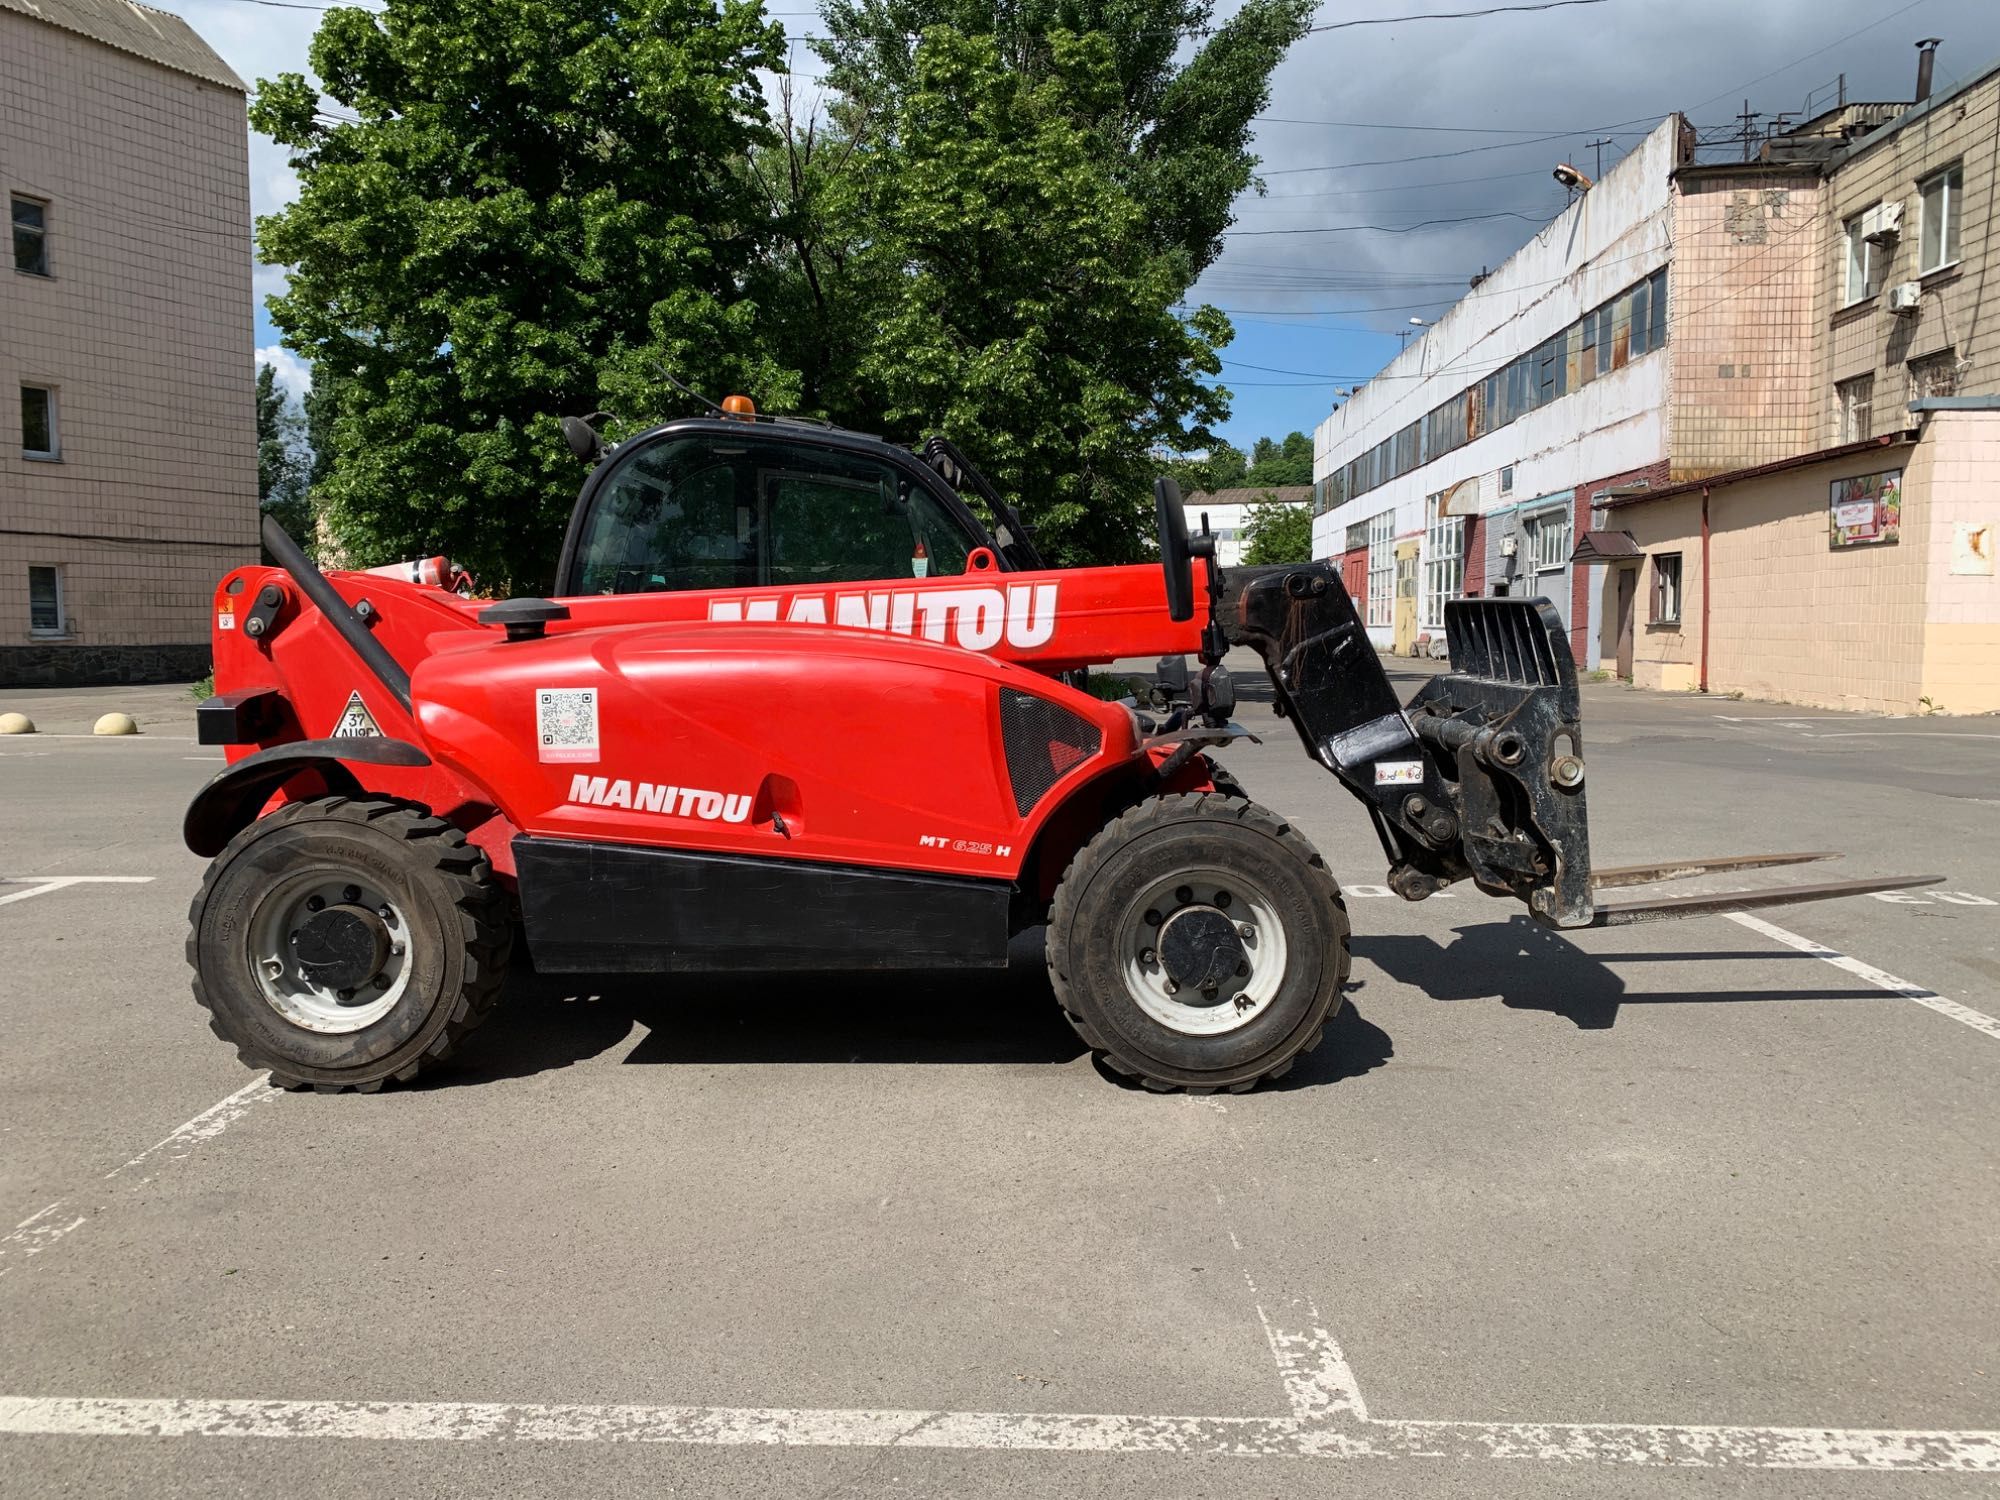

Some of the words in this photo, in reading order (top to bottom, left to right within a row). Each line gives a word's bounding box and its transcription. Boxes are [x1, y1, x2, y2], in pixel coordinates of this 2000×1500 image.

[348, 713, 365, 727] 37
[568, 774, 752, 823] MANITOU
[919, 835, 950, 848] MT
[952, 839, 992, 855] 625
[995, 845, 1011, 857] H
